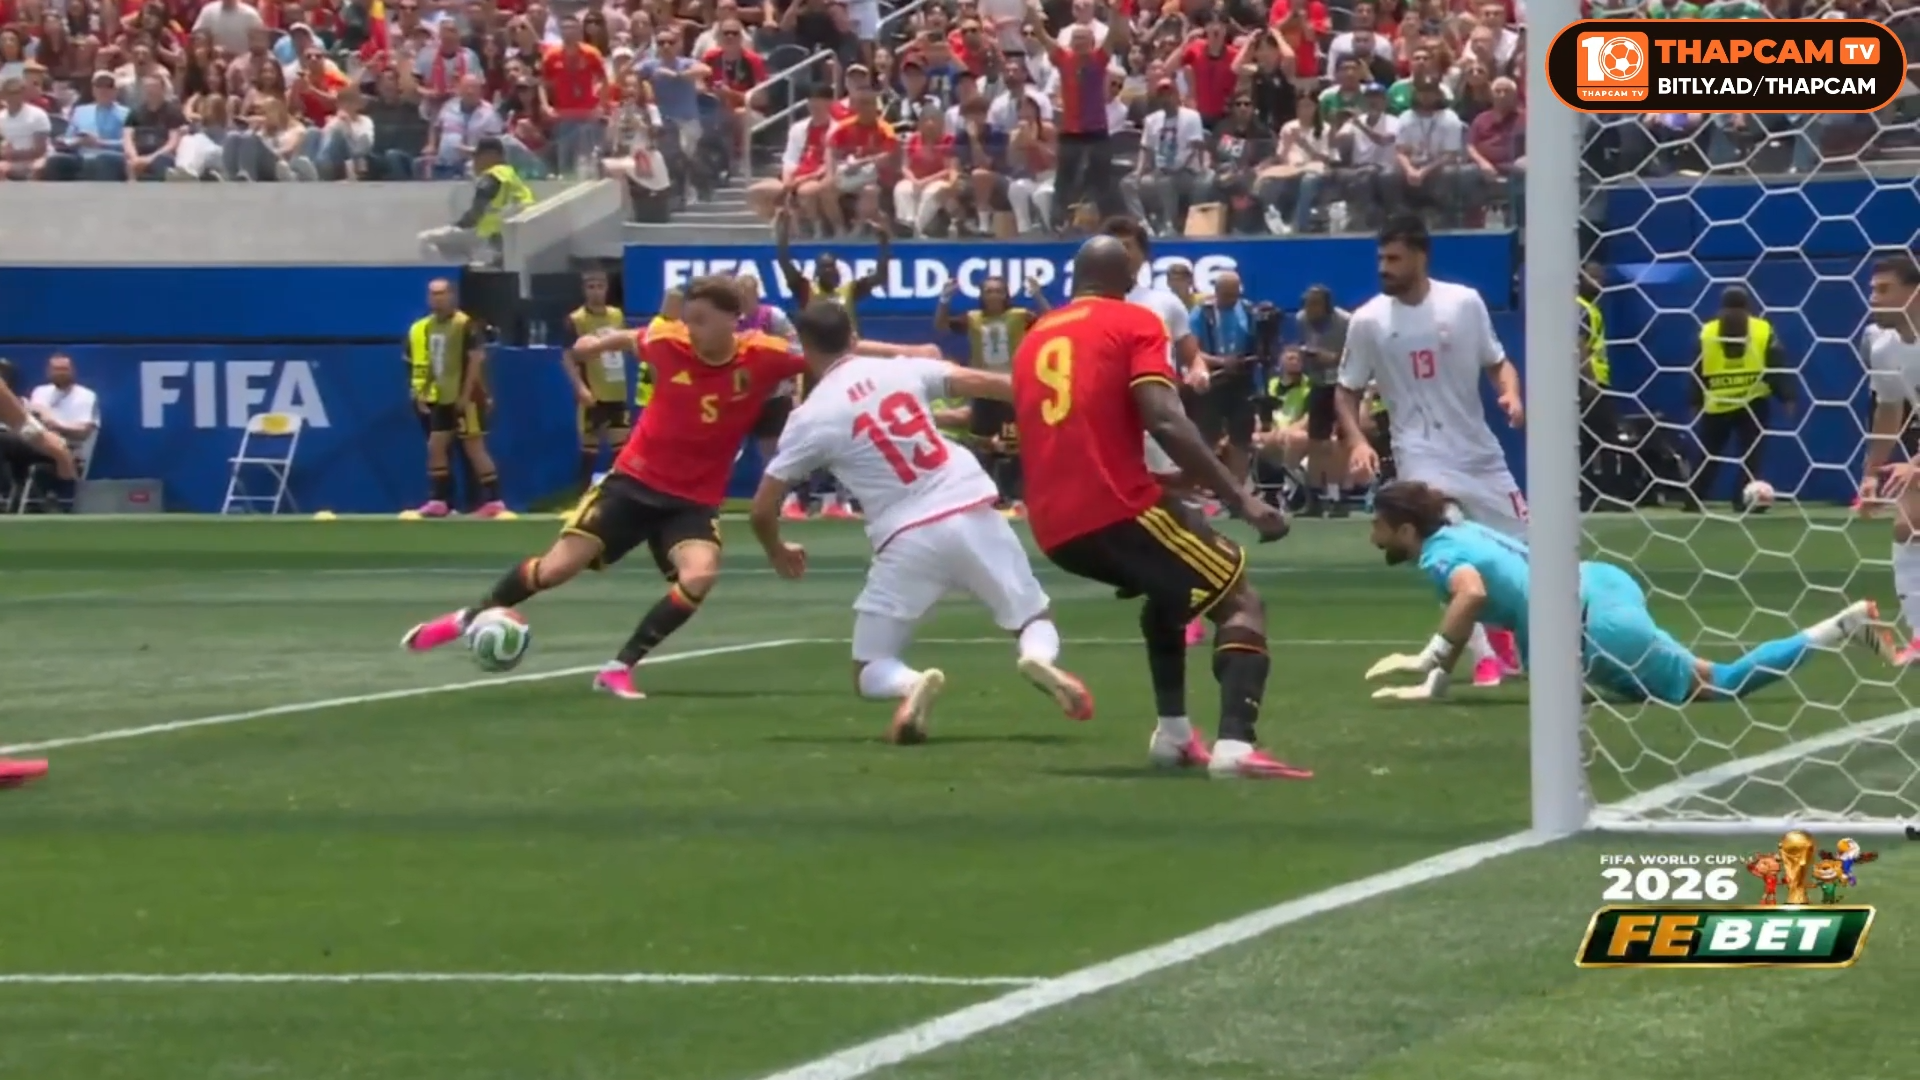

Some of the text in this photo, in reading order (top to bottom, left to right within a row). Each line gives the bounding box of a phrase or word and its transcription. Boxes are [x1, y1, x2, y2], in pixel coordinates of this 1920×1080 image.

[957, 258, 1055, 298] CUP
[140, 360, 331, 428] FIFA
[1035, 336, 1073, 426] 9
[1409, 349, 1436, 380] 13
[851, 390, 949, 485] 19
